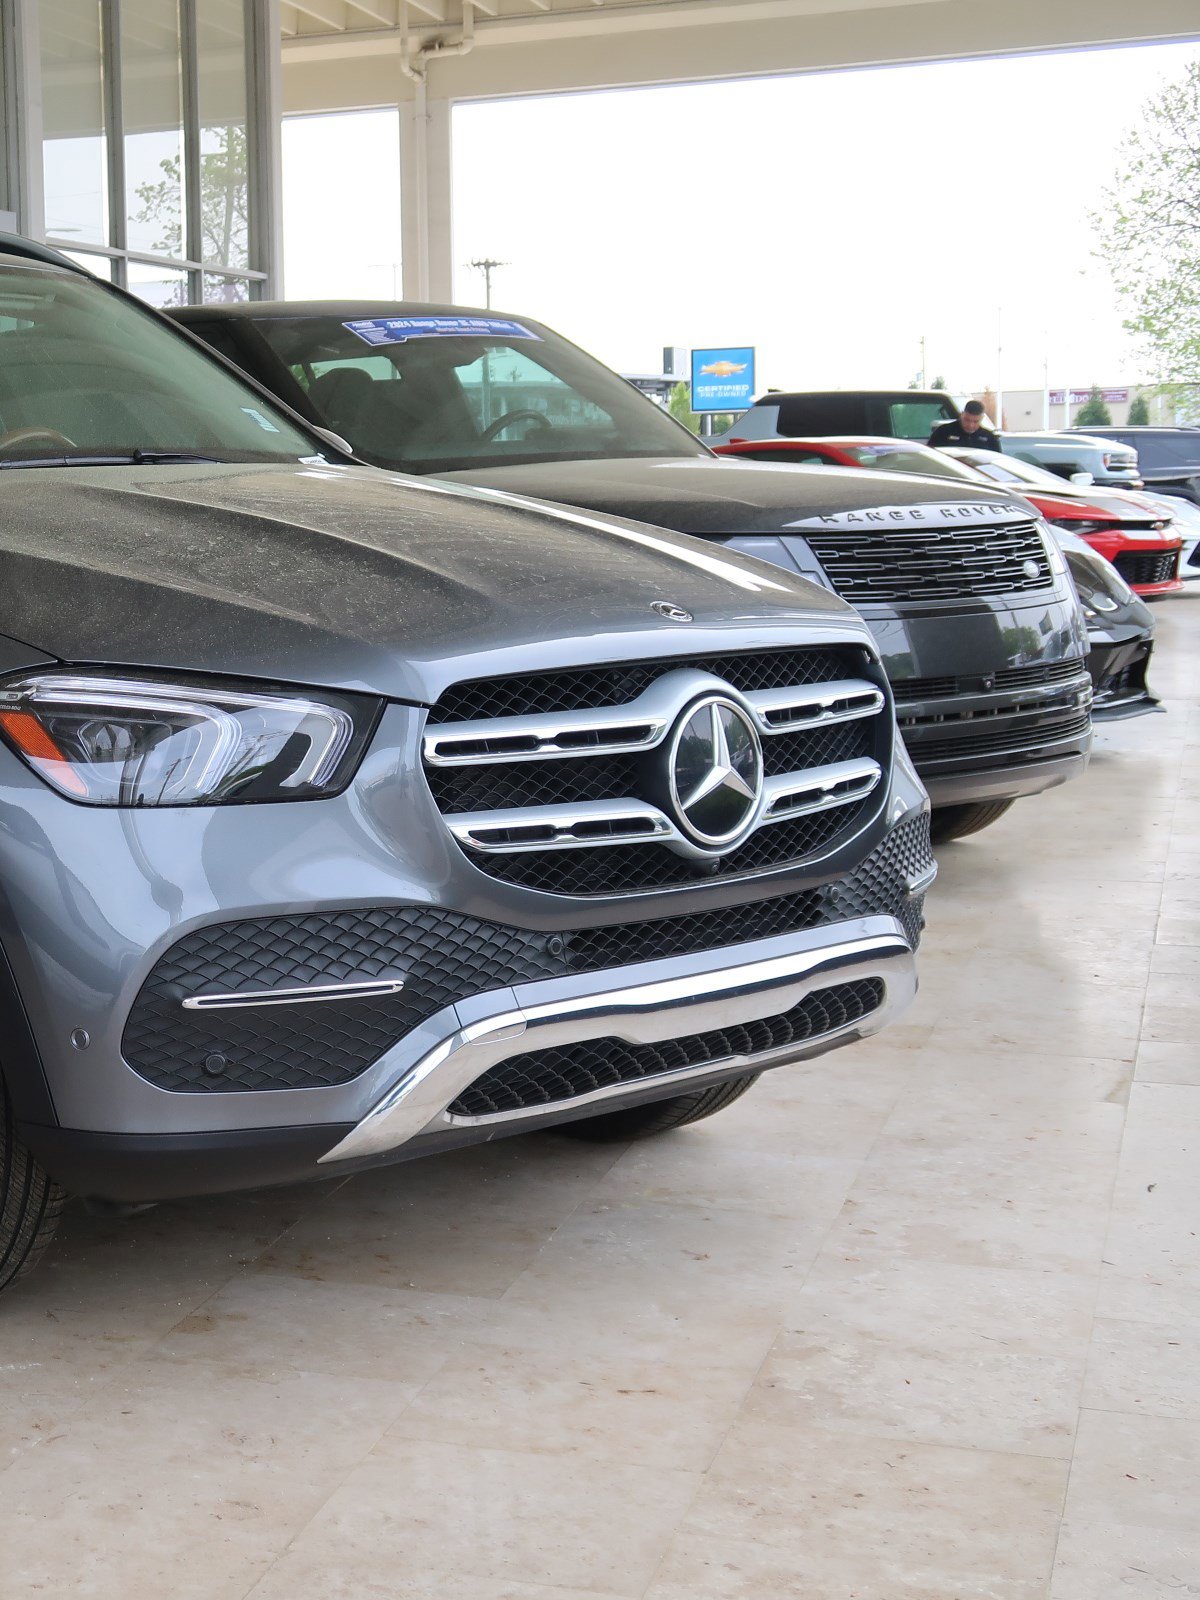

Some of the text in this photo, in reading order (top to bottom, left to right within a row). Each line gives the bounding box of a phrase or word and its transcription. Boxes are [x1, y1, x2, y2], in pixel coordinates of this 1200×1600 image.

[697, 384, 749, 392] CERTIFIED
[818, 505, 1016, 523] RANGE ROVER
